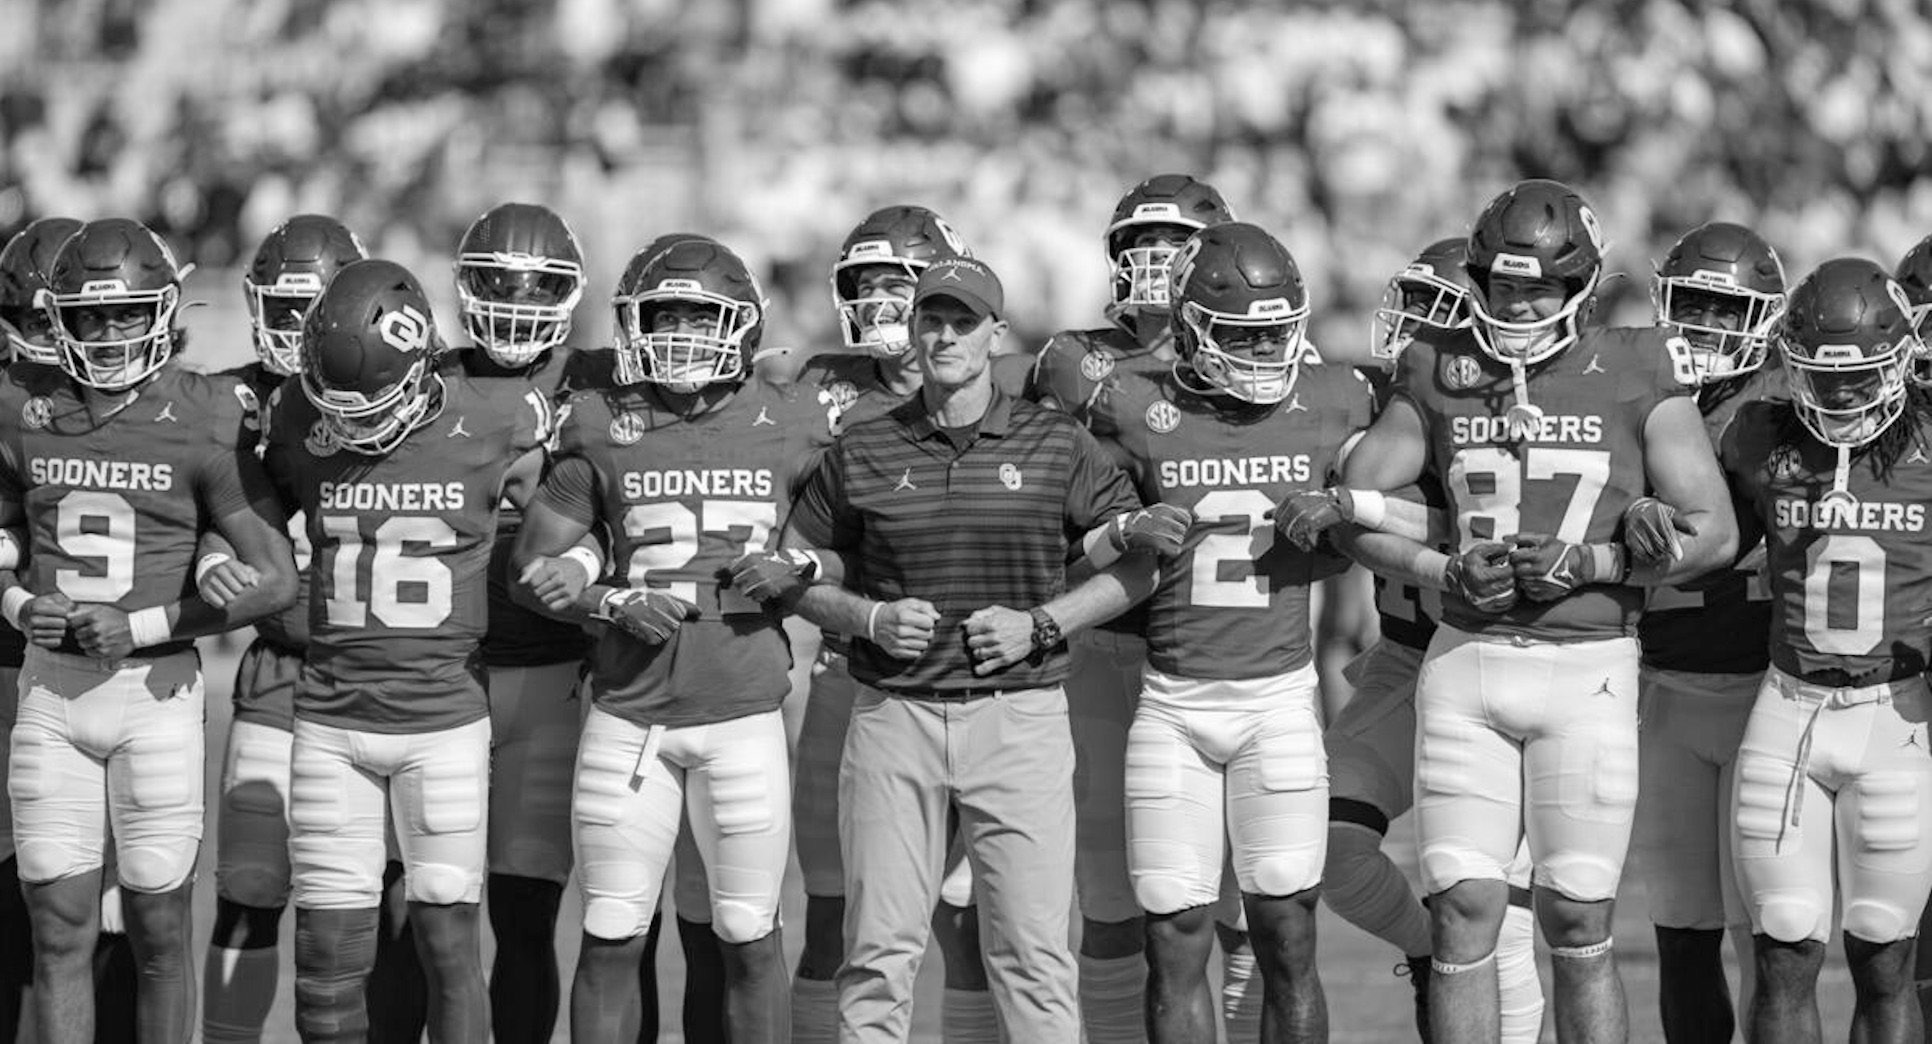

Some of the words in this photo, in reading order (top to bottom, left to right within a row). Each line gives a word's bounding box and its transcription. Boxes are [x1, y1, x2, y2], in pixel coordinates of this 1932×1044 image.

[1447, 357, 1481, 386] SEC
[610, 412, 644, 444] SEC
[1146, 400, 1181, 432] SEC
[31, 457, 173, 491] SOONERS
[624, 469, 772, 499] SOONERS
[1161, 454, 1311, 488] SOONERS
[320, 481, 465, 511] SOONERS
[1450, 447, 1611, 556] 87
[1775, 499, 1925, 532] SOONERS
[56, 490, 136, 602] 9
[622, 500, 778, 606] 27
[1190, 489, 1277, 608] 2
[322, 515, 457, 628] 16
[1804, 535, 1887, 655] 0
